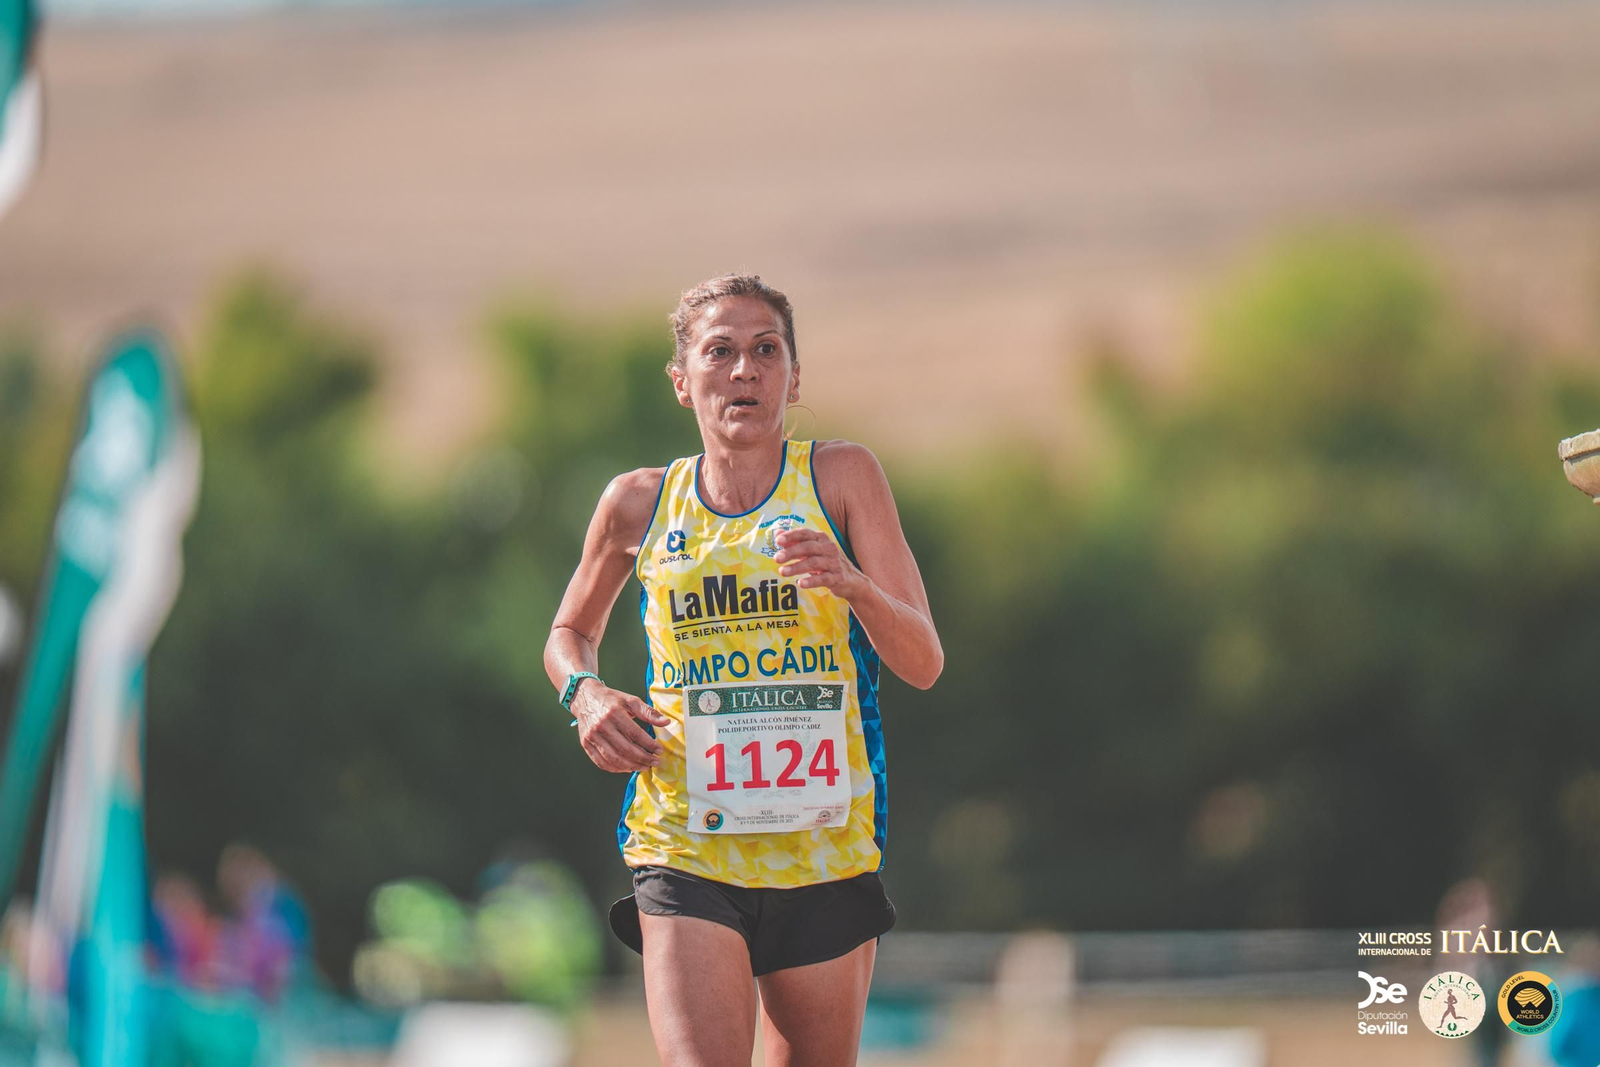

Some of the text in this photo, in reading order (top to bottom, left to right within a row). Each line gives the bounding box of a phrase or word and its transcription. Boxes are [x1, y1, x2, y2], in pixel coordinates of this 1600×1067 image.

[674, 619, 799, 641] SE SIENTA A LA MESA
[731, 687, 806, 708] ITÁLICA
[718, 725, 774, 734] POLIDEPORTIVO
[728, 717, 758, 725] NATALÍA
[705, 739, 840, 791] 1124
